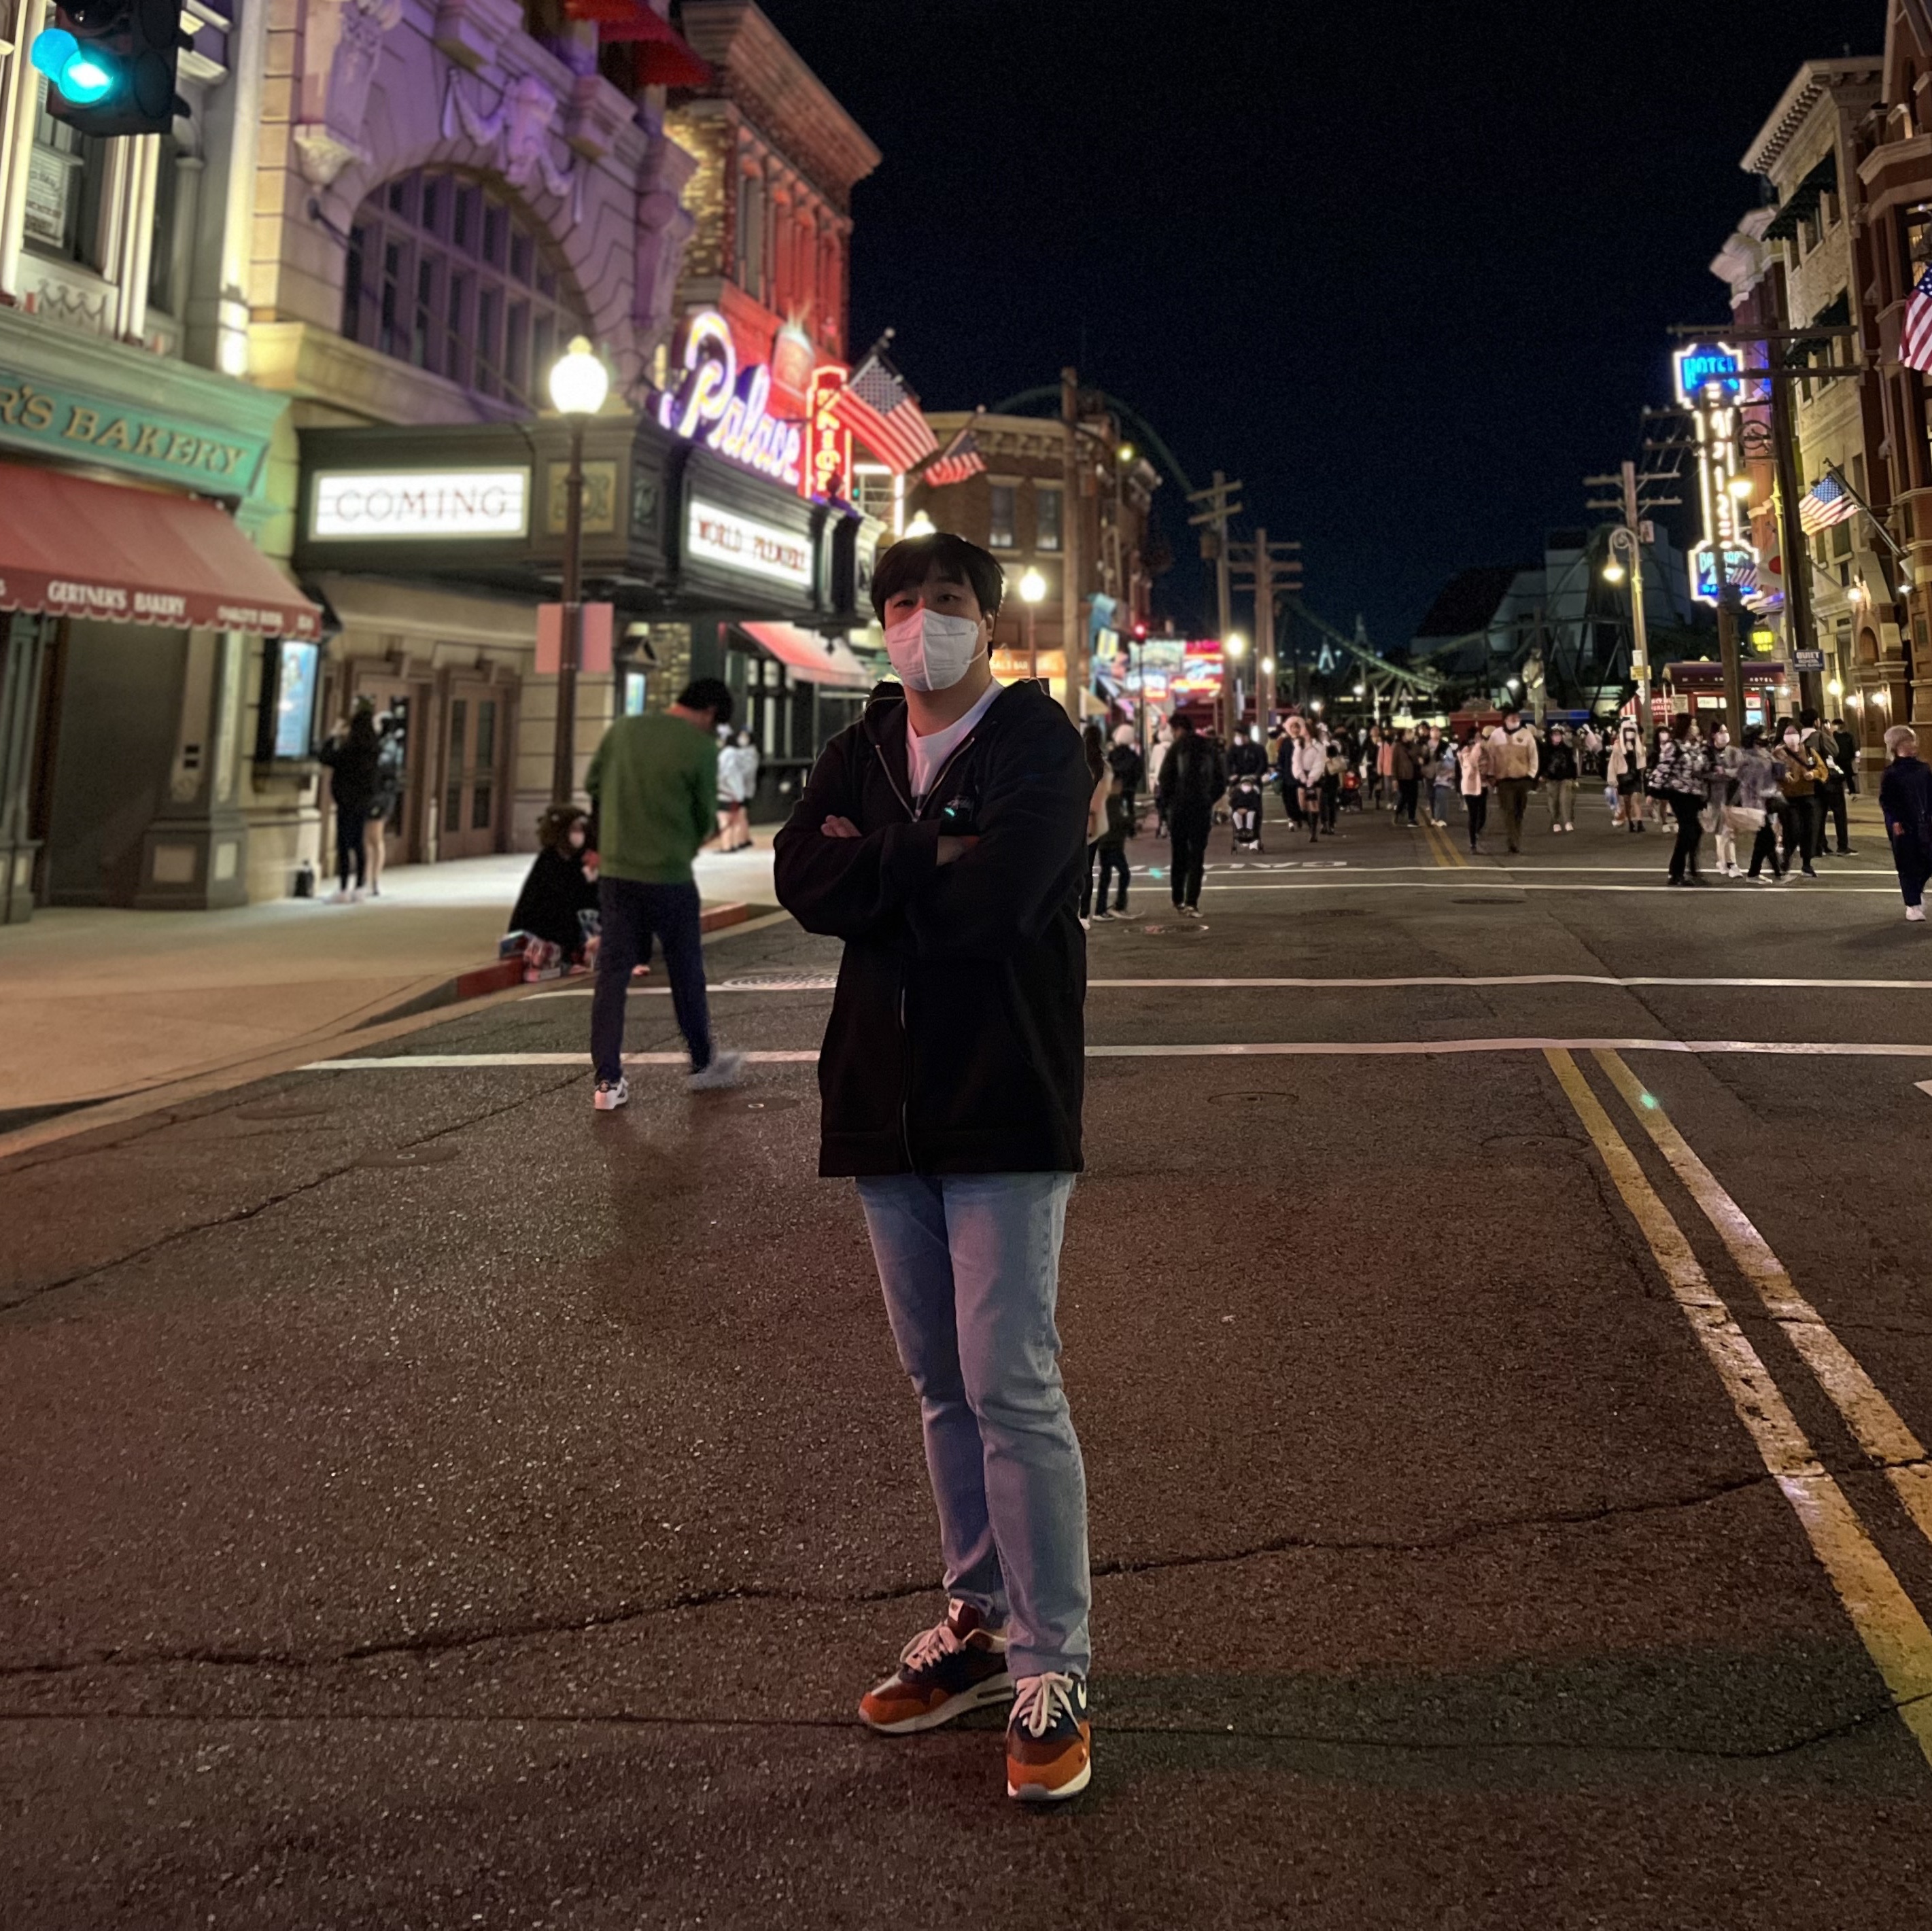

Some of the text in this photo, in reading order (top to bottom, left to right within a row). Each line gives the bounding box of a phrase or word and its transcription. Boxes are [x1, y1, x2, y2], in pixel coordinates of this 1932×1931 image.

[678, 311, 801, 487] Palace
[62, 404, 247, 474] BAKERY
[336, 484, 507, 522] COMING
[1796, 651, 1821, 659] QUIET
